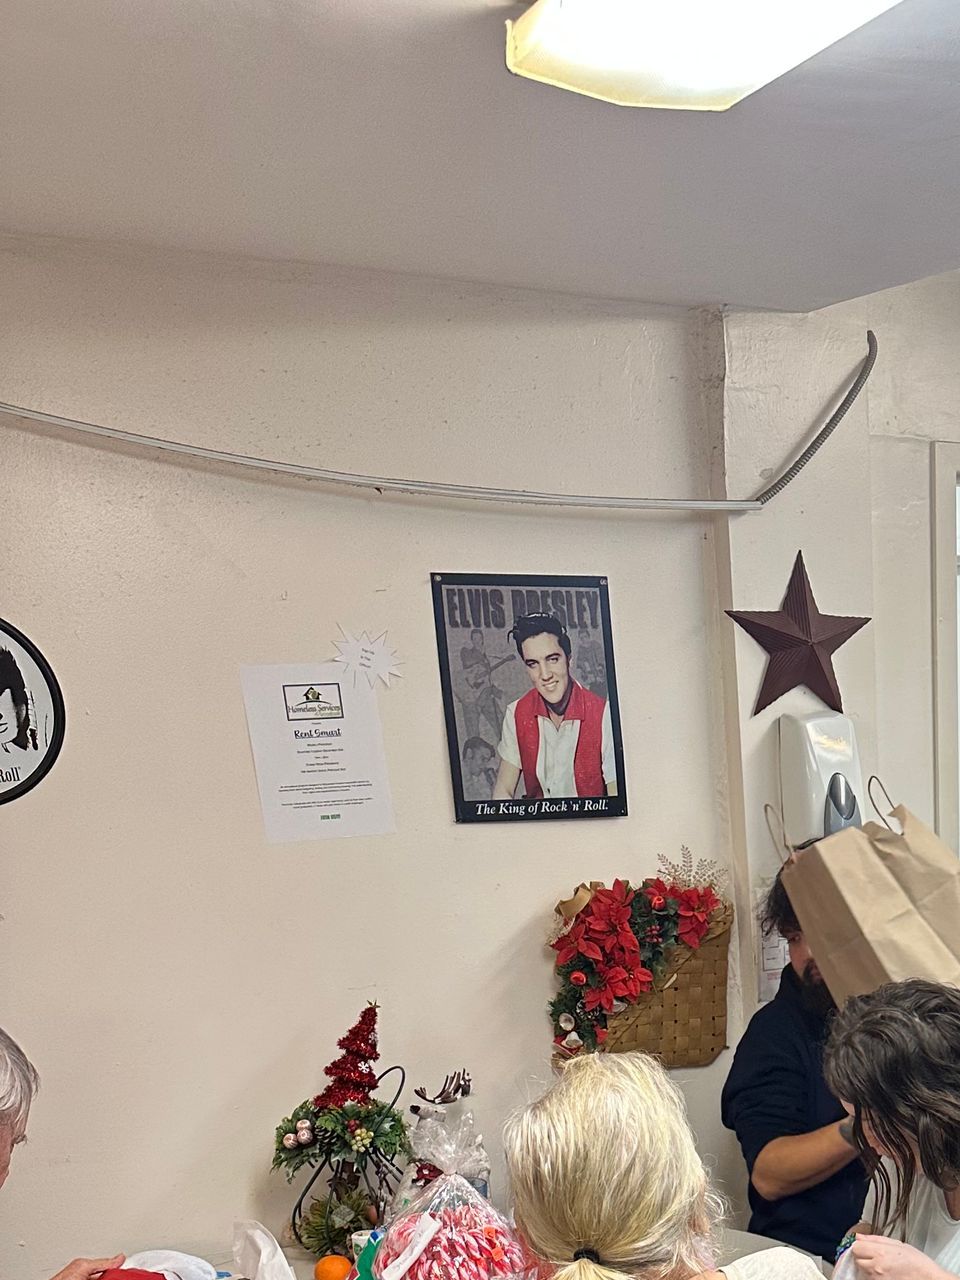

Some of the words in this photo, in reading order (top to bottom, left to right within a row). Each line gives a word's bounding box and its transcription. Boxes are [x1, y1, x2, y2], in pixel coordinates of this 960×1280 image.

[446, 588, 506, 629] ELVIS
[288, 704, 317, 713] Homeless
[317, 704, 341, 712] Services
[294, 729, 314, 738] Rent
[314, 728, 342, 737] Smart
[476, 803, 496, 815] The
[499, 802, 526, 816] King
[528, 801, 540, 815] of
[541, 800, 568, 813] Rock
[570, 801, 581, 811] 'n'
